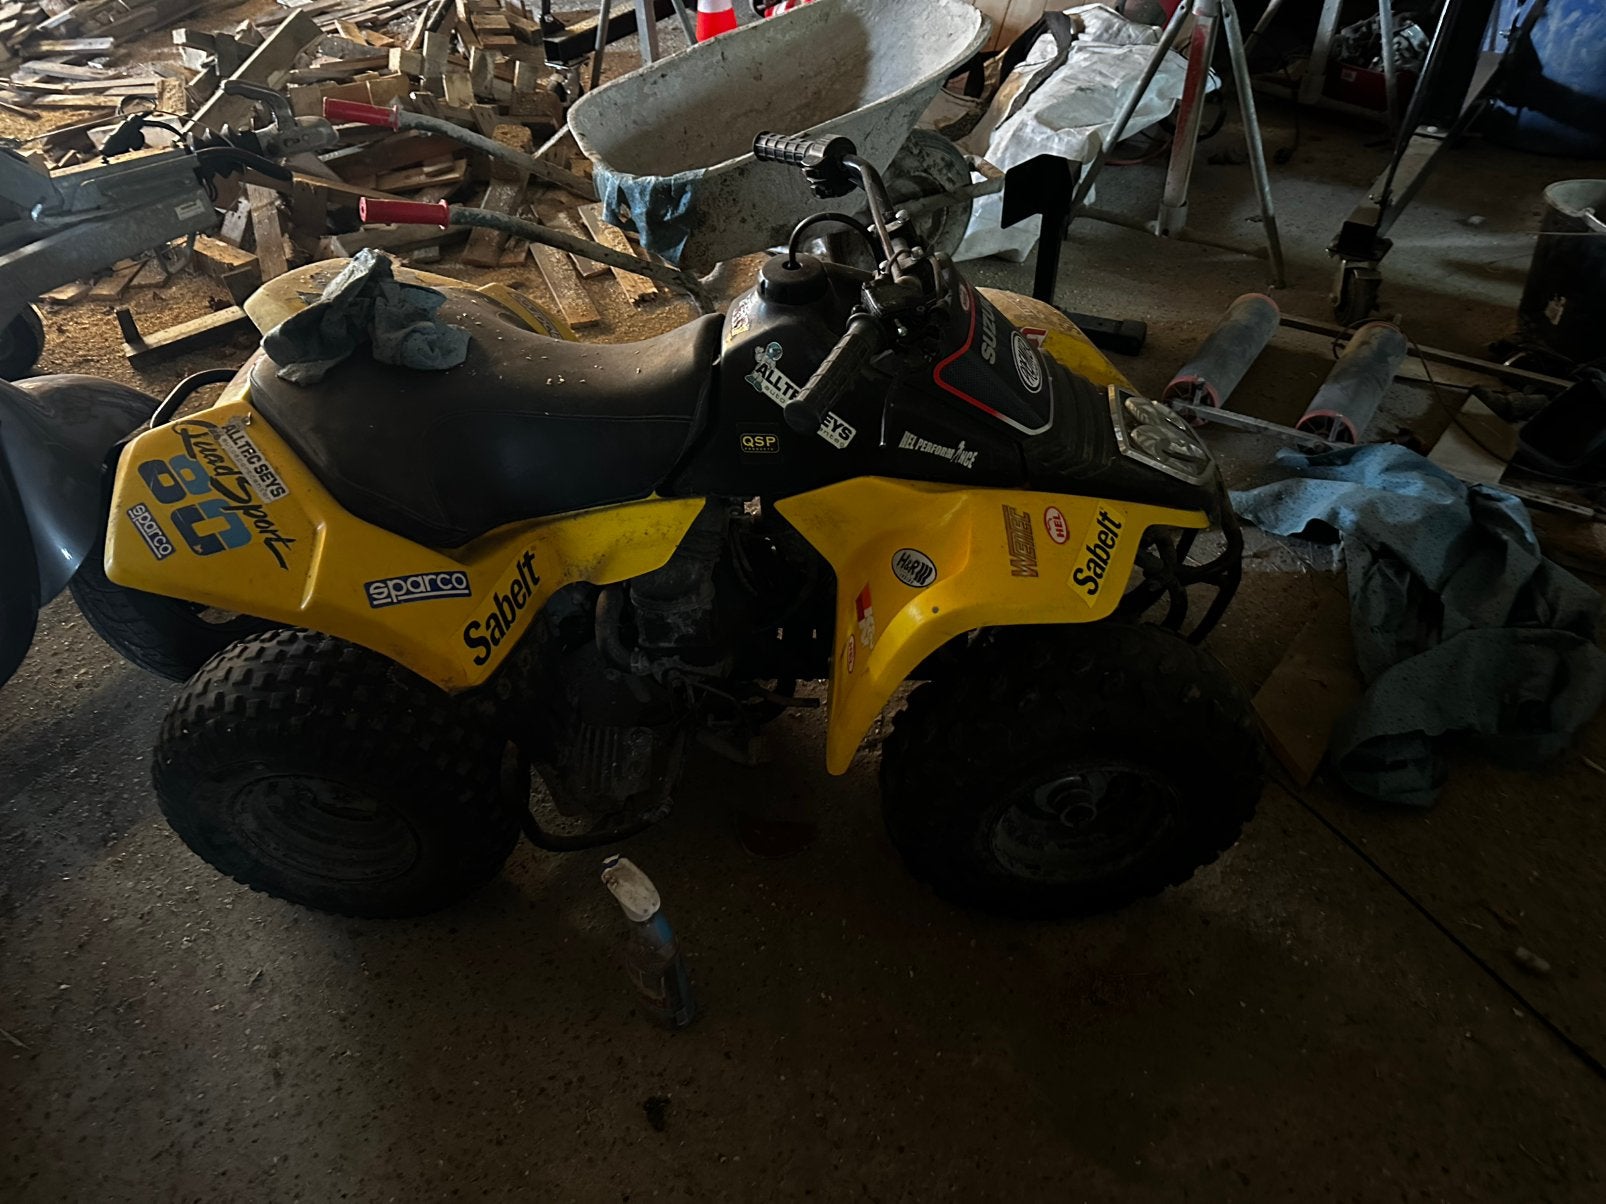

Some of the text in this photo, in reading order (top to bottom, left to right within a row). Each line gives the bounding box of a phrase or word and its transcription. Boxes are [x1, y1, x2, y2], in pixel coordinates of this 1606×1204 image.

[981, 301, 996, 366] SUZU
[756, 363, 853, 441] ALLTE EYS
[222, 425, 287, 498] ALLTEC SEYS
[742, 435, 776, 447] QSP
[130, 504, 173, 556] sparco
[1052, 514, 1065, 538] HEL
[1073, 510, 1122, 596] Sabelt
[369, 572, 469, 603] sparco
[463, 550, 540, 666] Sabelt
